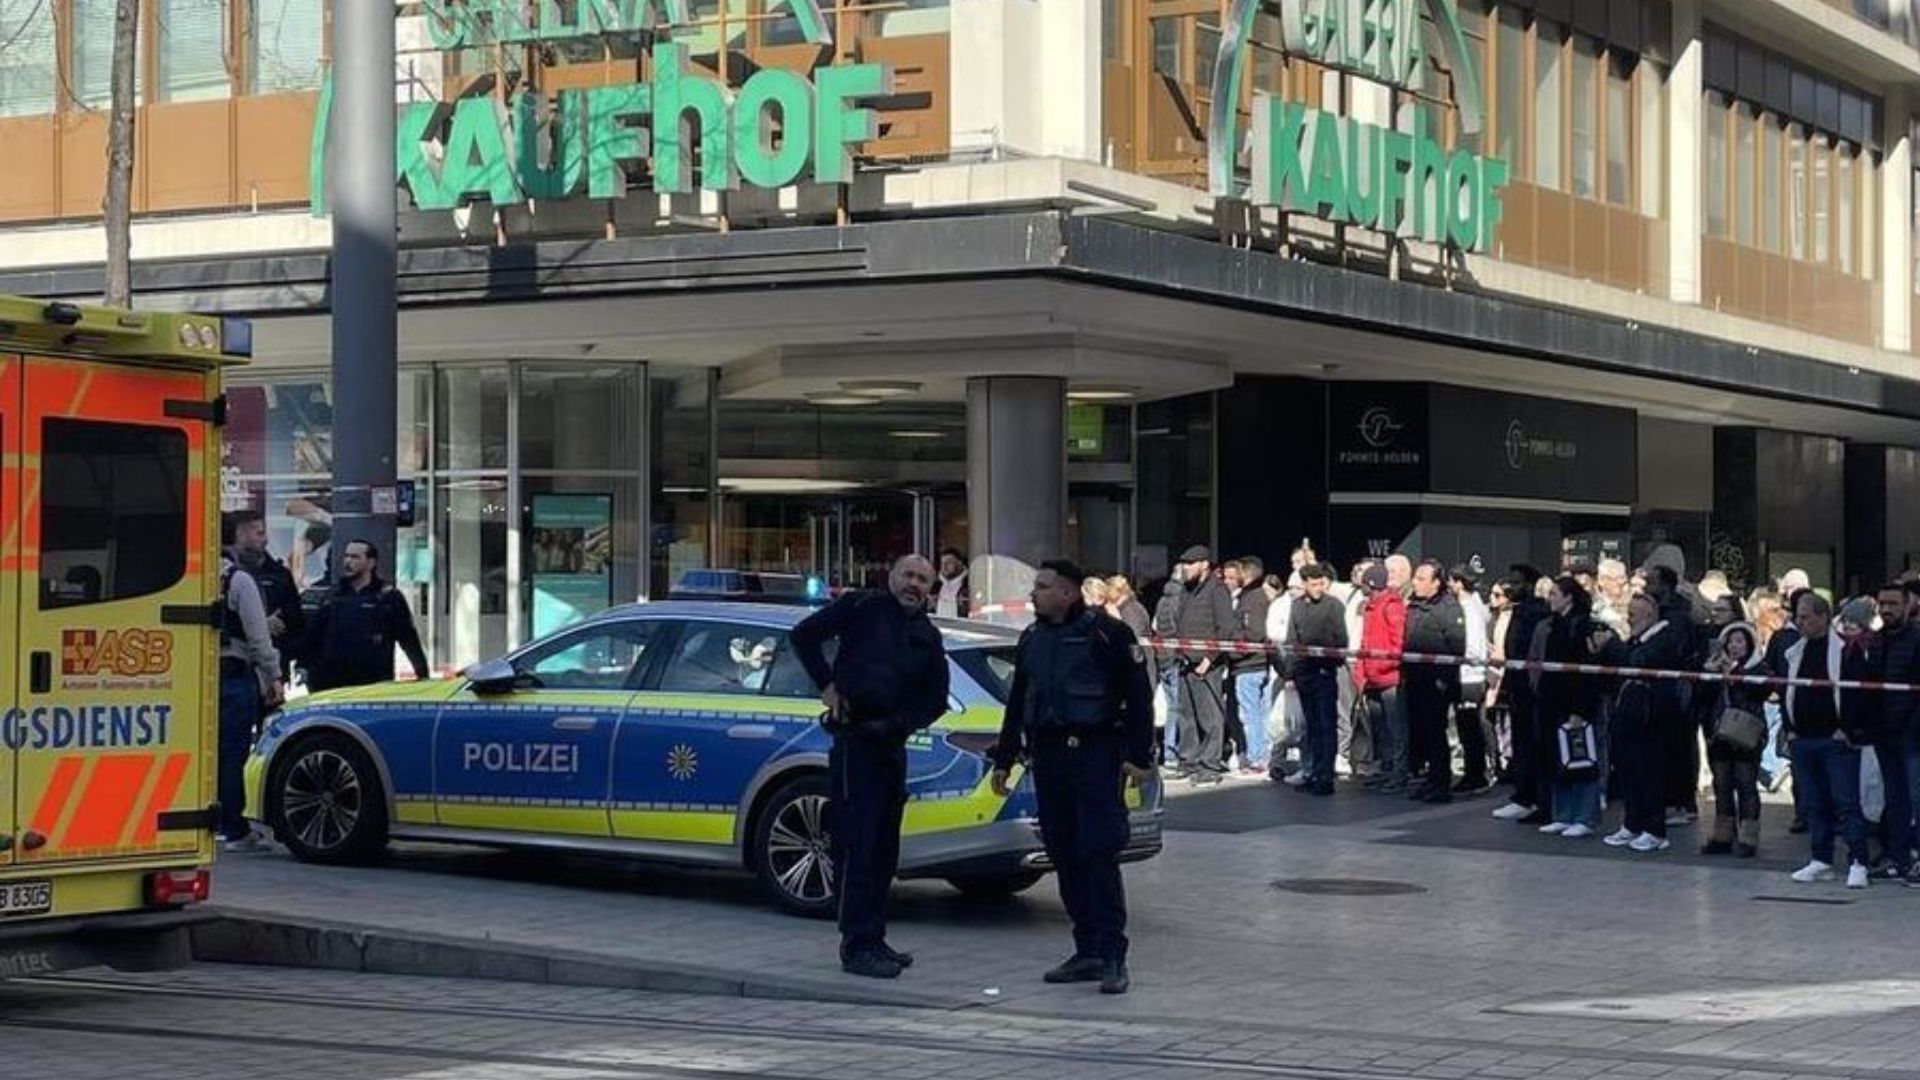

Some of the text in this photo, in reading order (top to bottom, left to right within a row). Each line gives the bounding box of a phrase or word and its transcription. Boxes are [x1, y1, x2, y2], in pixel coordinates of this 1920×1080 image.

[95, 628, 174, 677] ASB
[3, 704, 171, 749] GSDIENST
[464, 742, 578, 772] POLIZEI
